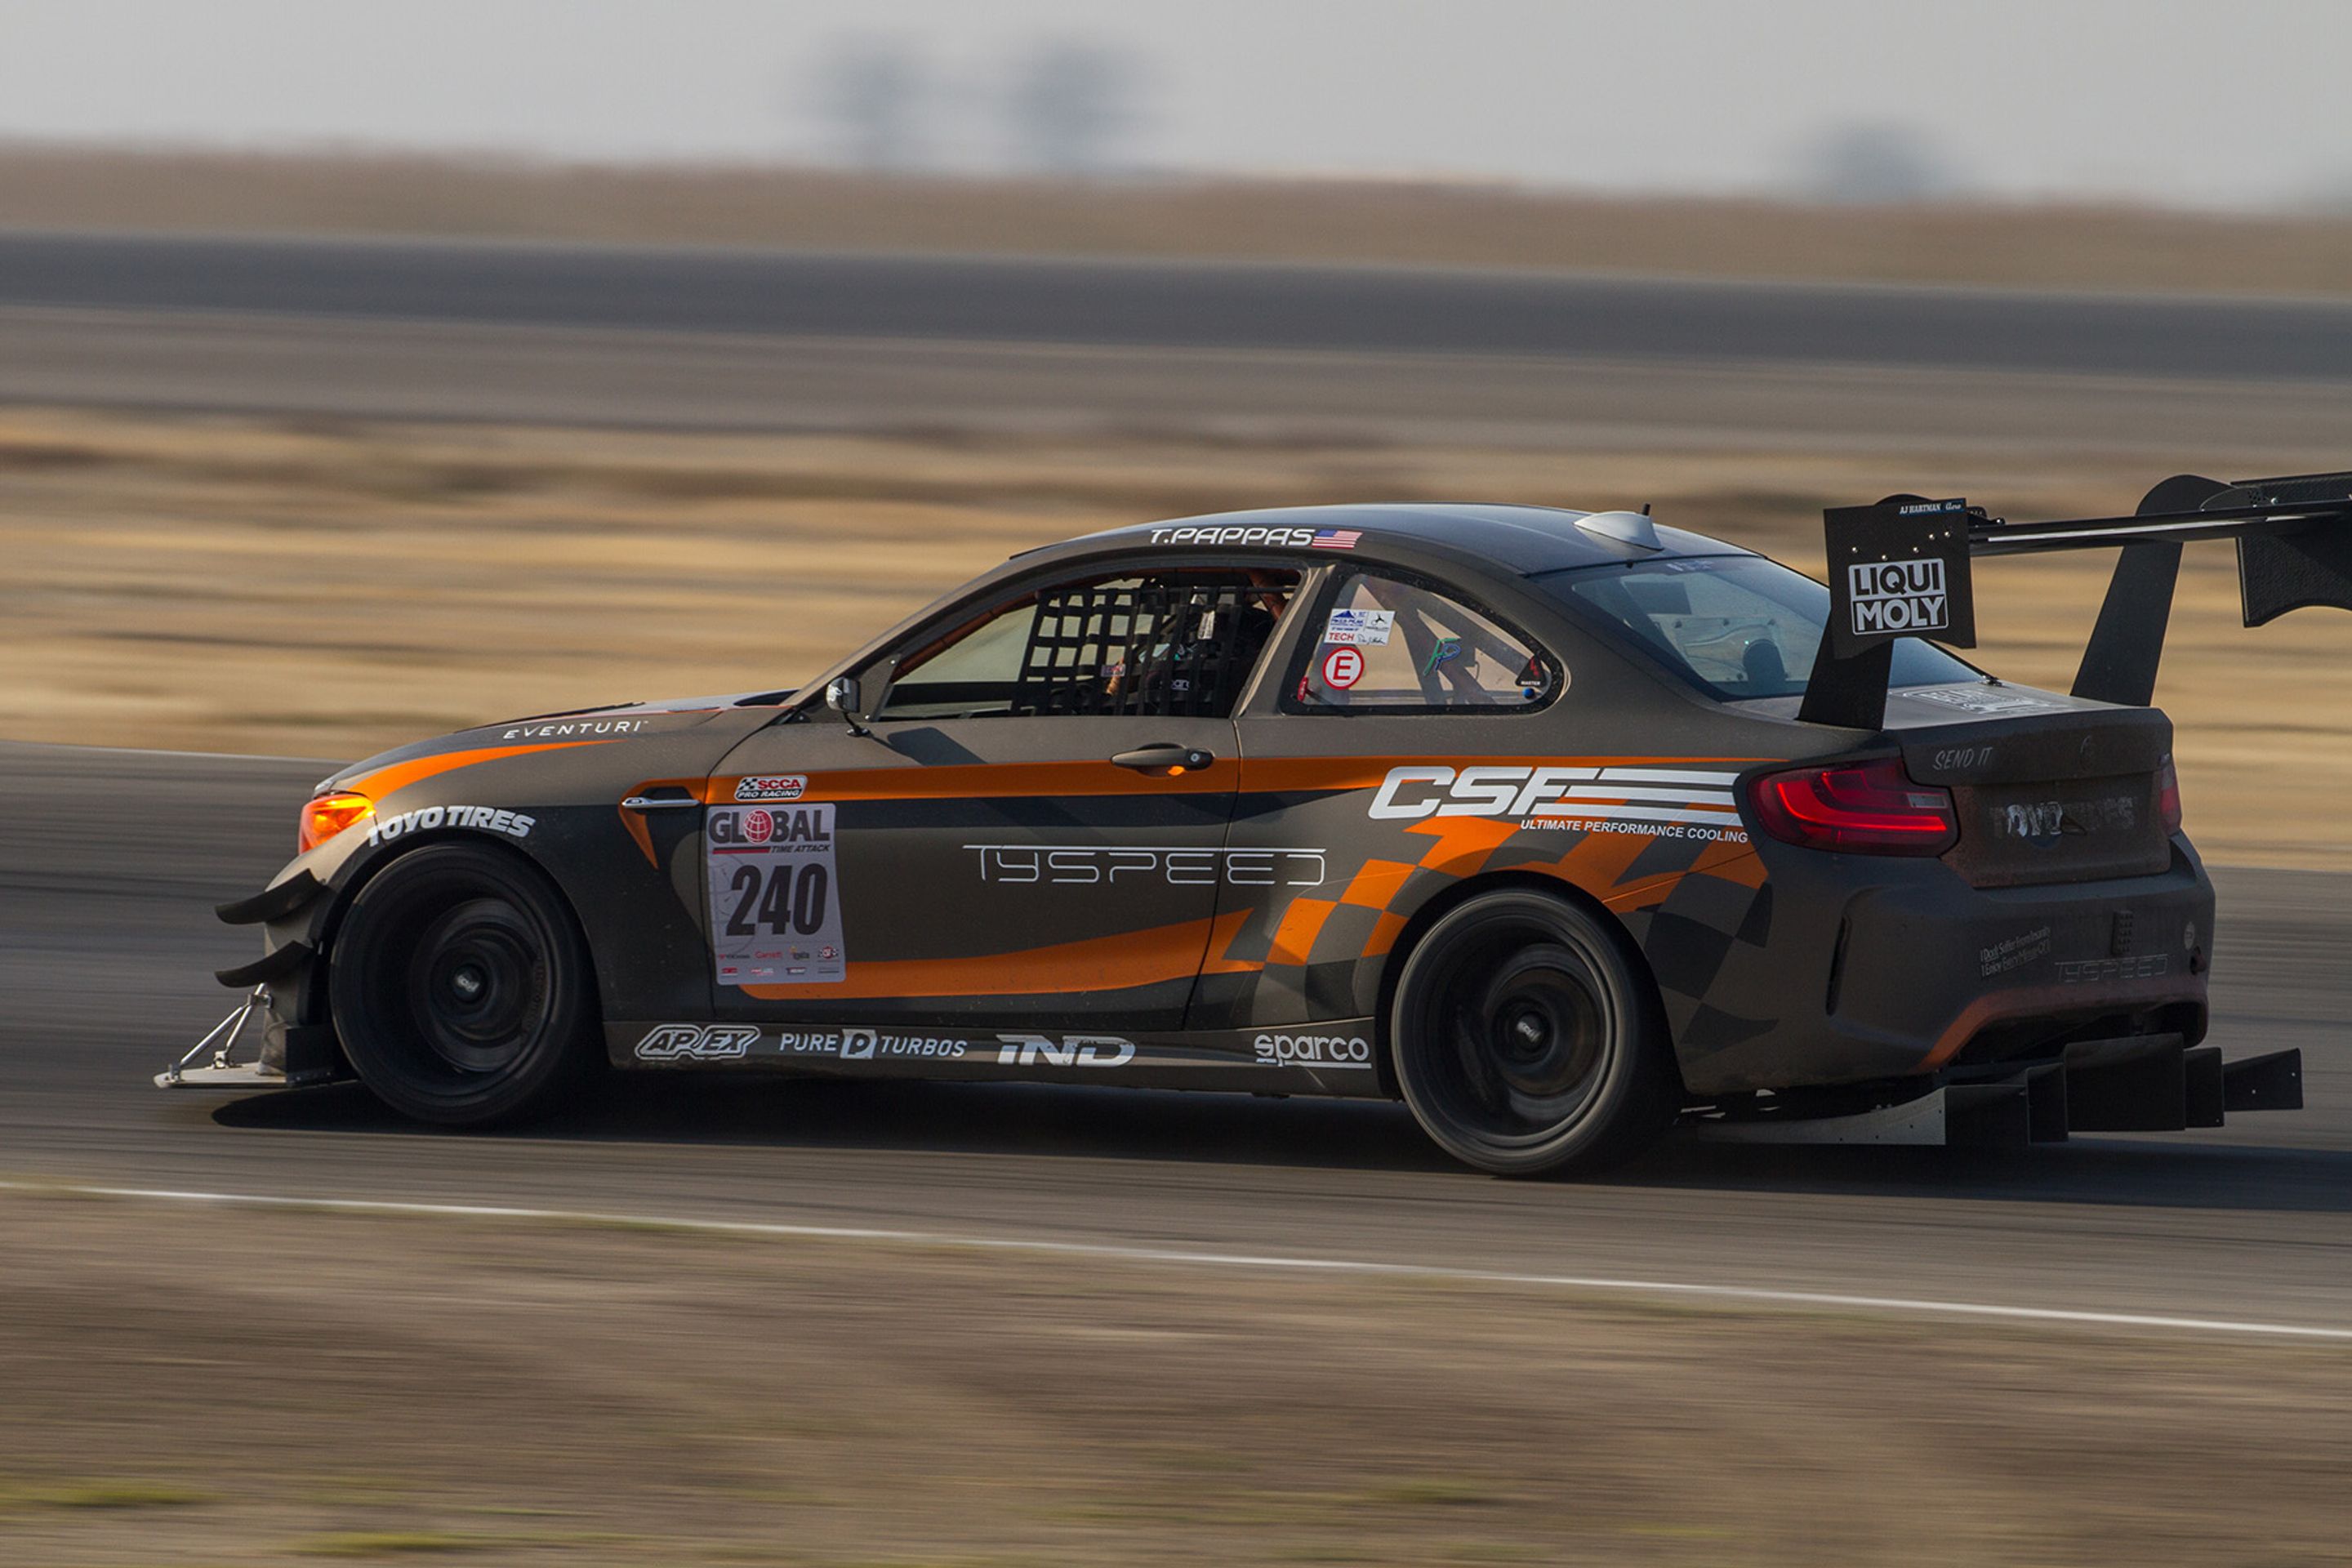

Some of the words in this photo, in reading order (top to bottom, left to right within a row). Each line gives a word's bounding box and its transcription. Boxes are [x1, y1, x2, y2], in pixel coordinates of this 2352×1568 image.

[1909, 503, 1941, 514] HARTMAN
[1151, 528, 1316, 546] T.PAPPAS
[1854, 562, 1940, 596] LIQUI
[1855, 596, 1944, 631] MOLY
[1329, 632, 1355, 641] TECH
[1333, 656, 1354, 679] E
[503, 720, 642, 739] EVENTURI
[1932, 748, 1974, 770] SEND
[1977, 746, 1993, 766] IT
[758, 778, 801, 791] SCCA
[760, 790, 800, 798] RACING
[367, 805, 444, 848] TOYO
[444, 805, 536, 838] TIRES
[708, 808, 831, 844] GLOBAL
[1520, 819, 1581, 831] ULTIMATE
[1584, 820, 1685, 838] PERFORMANCE
[1687, 827, 1748, 844] COOLING
[771, 845, 794, 853] TIME
[794, 844, 830, 853] ATTACK
[726, 862, 828, 937] 240
[639, 1029, 756, 1055] APEX
[780, 1032, 839, 1052] PURE
[880, 1036, 968, 1058] TURBOS
[1254, 1033, 1370, 1067] sparco
